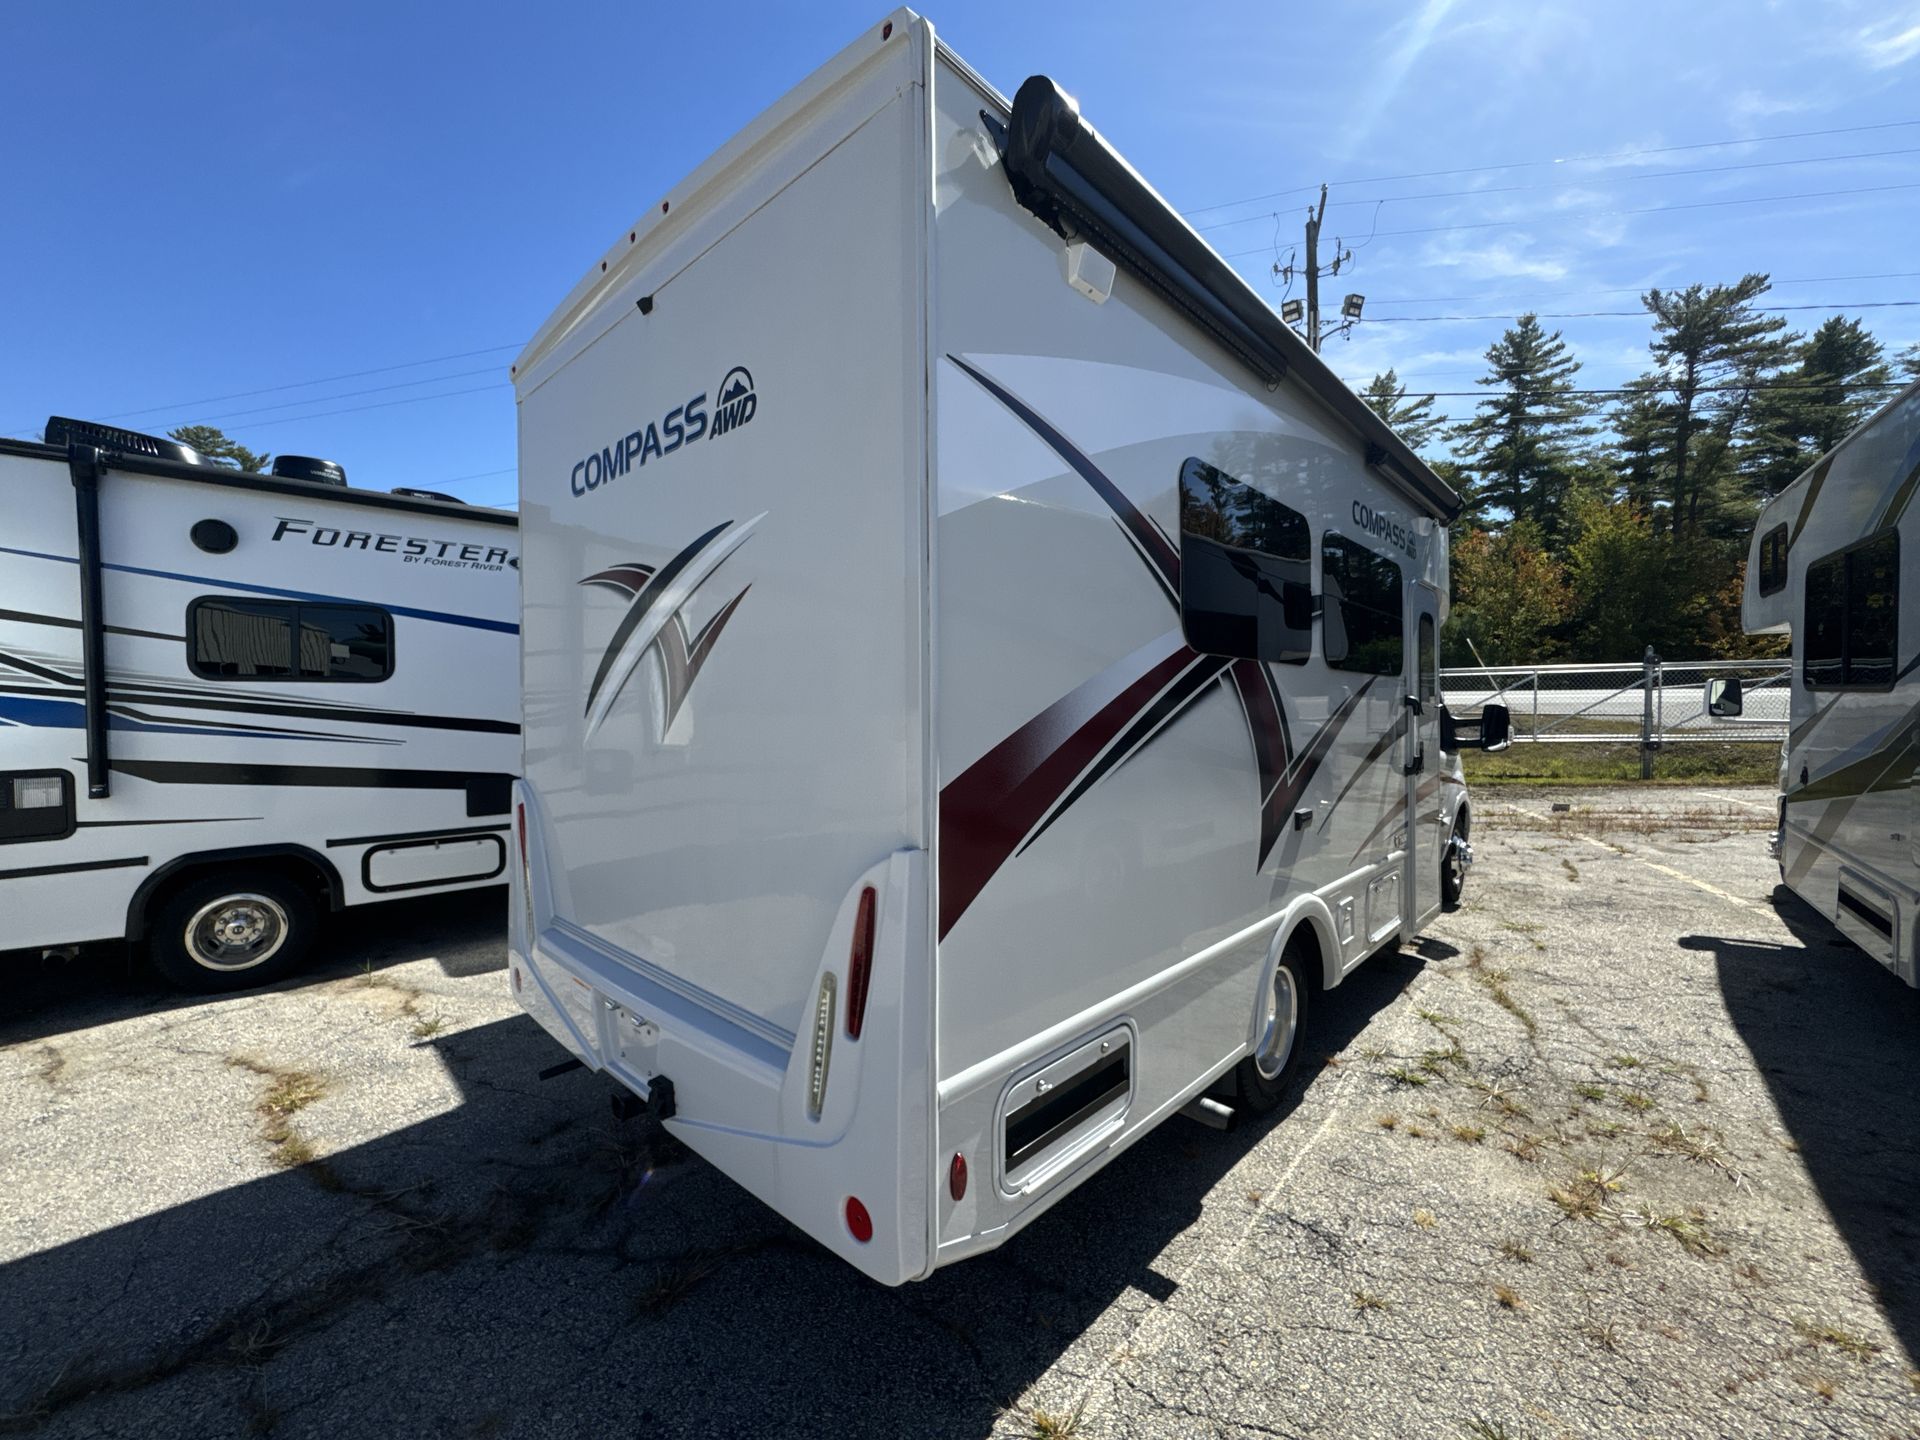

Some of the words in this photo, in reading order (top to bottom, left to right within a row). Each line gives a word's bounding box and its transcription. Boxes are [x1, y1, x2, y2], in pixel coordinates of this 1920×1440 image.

[571, 391, 708, 498] COMPASS
[709, 392, 757, 441] AWD
[271, 516, 508, 564] FORESTER
[1352, 500, 1406, 550] COMPASS
[403, 555, 421, 563] BY
[424, 557, 468, 568] FOREST
[471, 562, 503, 571] RIVER
